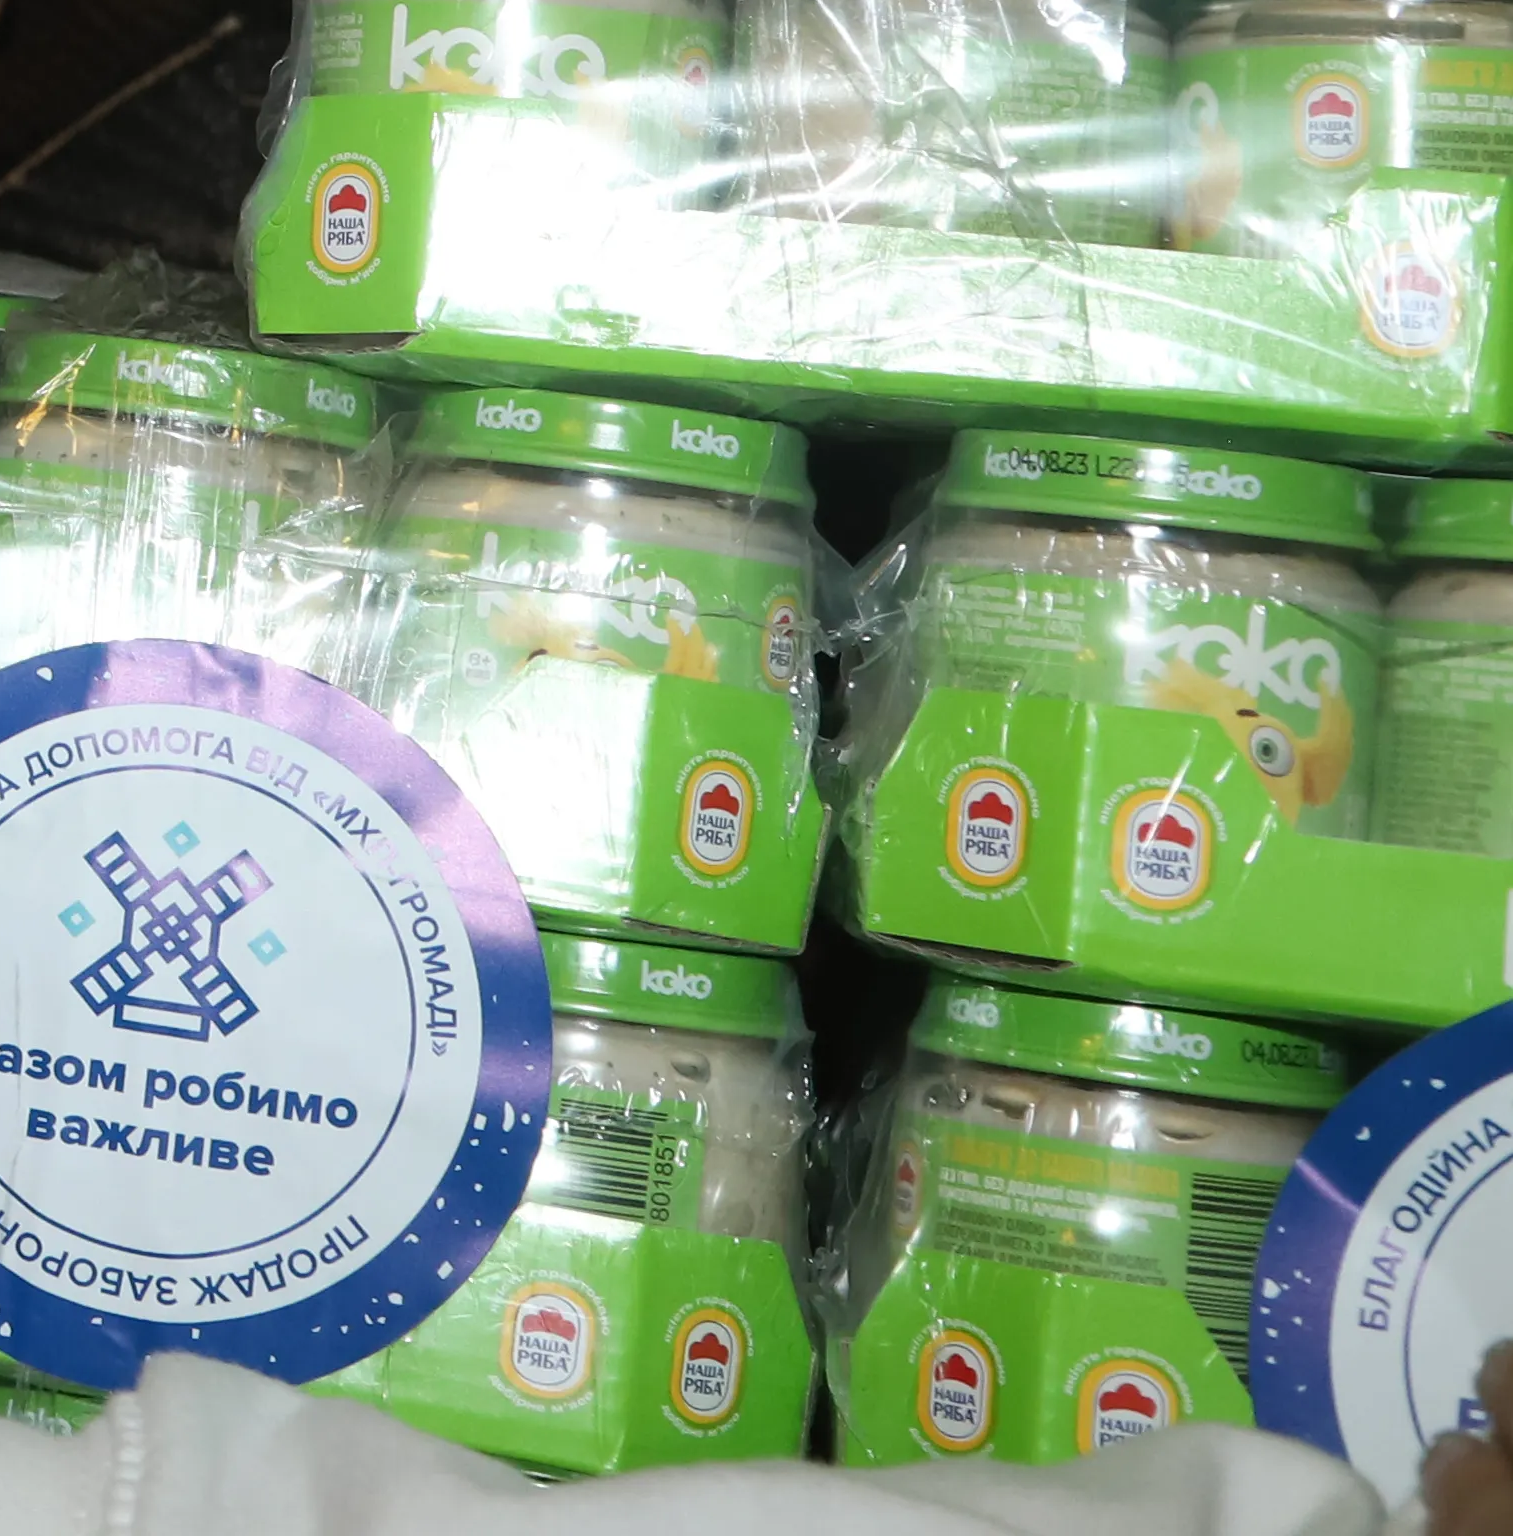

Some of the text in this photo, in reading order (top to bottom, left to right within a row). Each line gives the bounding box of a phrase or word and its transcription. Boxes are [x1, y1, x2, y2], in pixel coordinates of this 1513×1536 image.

[330, 152, 391, 204] гарантовано
[328, 217, 365, 230] НАША
[327, 230, 366, 247] РЯБА
[475, 397, 542, 434] koko
[671, 419, 741, 460] koko
[23, 725, 236, 787] ДОПОМОГА
[245, 746, 310, 800] ВІД
[697, 813, 736, 831] НАША
[965, 824, 1010, 842] НАША
[695, 828, 735, 848] РЯБА
[965, 840, 1011, 860] РЯБА
[1136, 847, 1191, 865] НАША
[640, 959, 712, 1001] koko
[144, 1061, 359, 1131] робимо
[26, 1107, 275, 1178] важливе
[649, 1134, 677, 1222] 801851
[1357, 1115, 1513, 1332] БЛАГОДІЙНА
[196, 1214, 371, 1308] ПРОДАЖ
[518, 1335, 570, 1356] НАША
[516, 1349, 571, 1374] РЯБА
[686, 1363, 725, 1379] НАША
[684, 1377, 725, 1397] РЯБА
[933, 1387, 977, 1407] НАША
[932, 1401, 977, 1425] РЯБА
